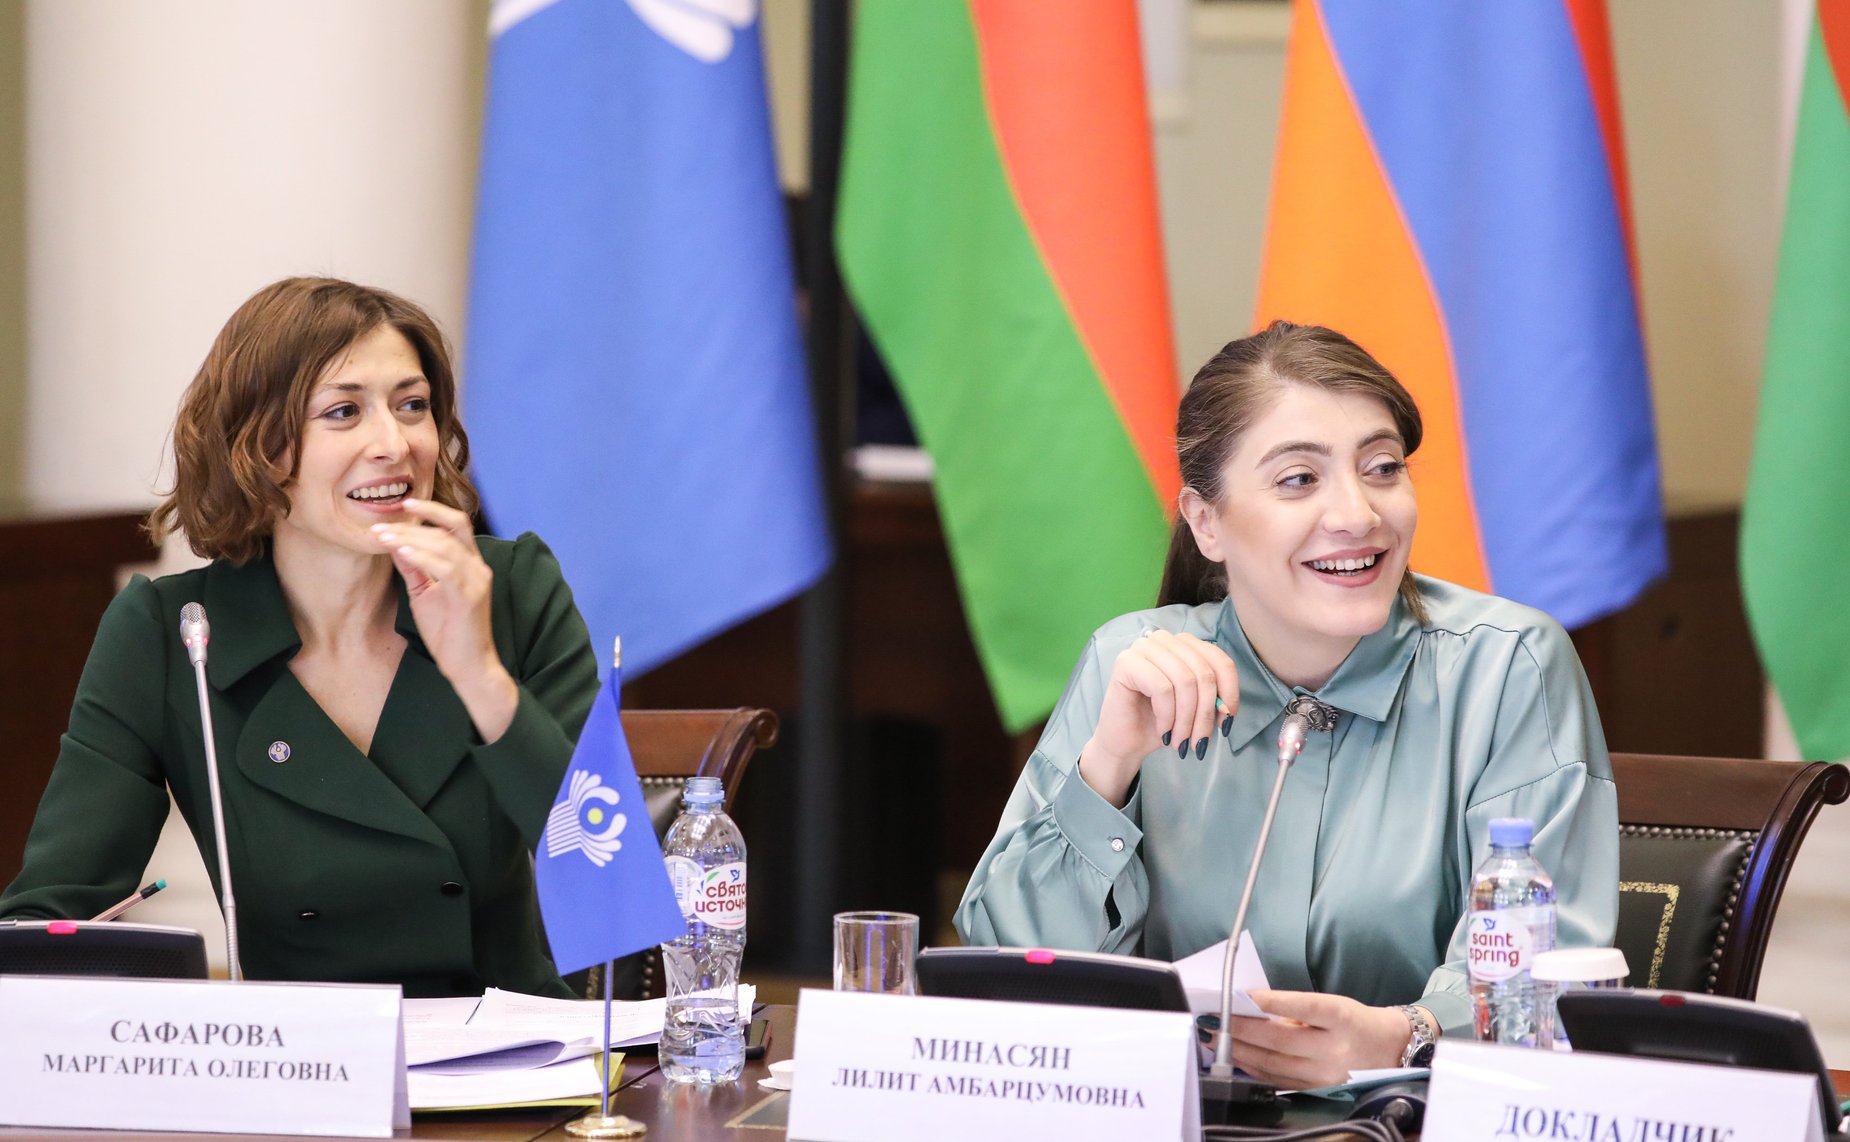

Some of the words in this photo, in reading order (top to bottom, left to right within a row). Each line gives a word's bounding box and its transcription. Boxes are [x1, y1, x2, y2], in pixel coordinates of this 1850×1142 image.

[1472, 932, 1514, 947] saint
[1469, 947, 1520, 967] spring
[110, 1020, 285, 1048] САФАРОВА
[42, 1053, 199, 1077] МАРГАРИТА
[207, 1058, 350, 1082] ОЛЕГОВНА
[911, 1036, 1072, 1071] МИНАСЯН
[832, 1067, 922, 1092] ЛИЛИТ
[926, 1076, 1145, 1109] АМБАРЦУМОВНА
